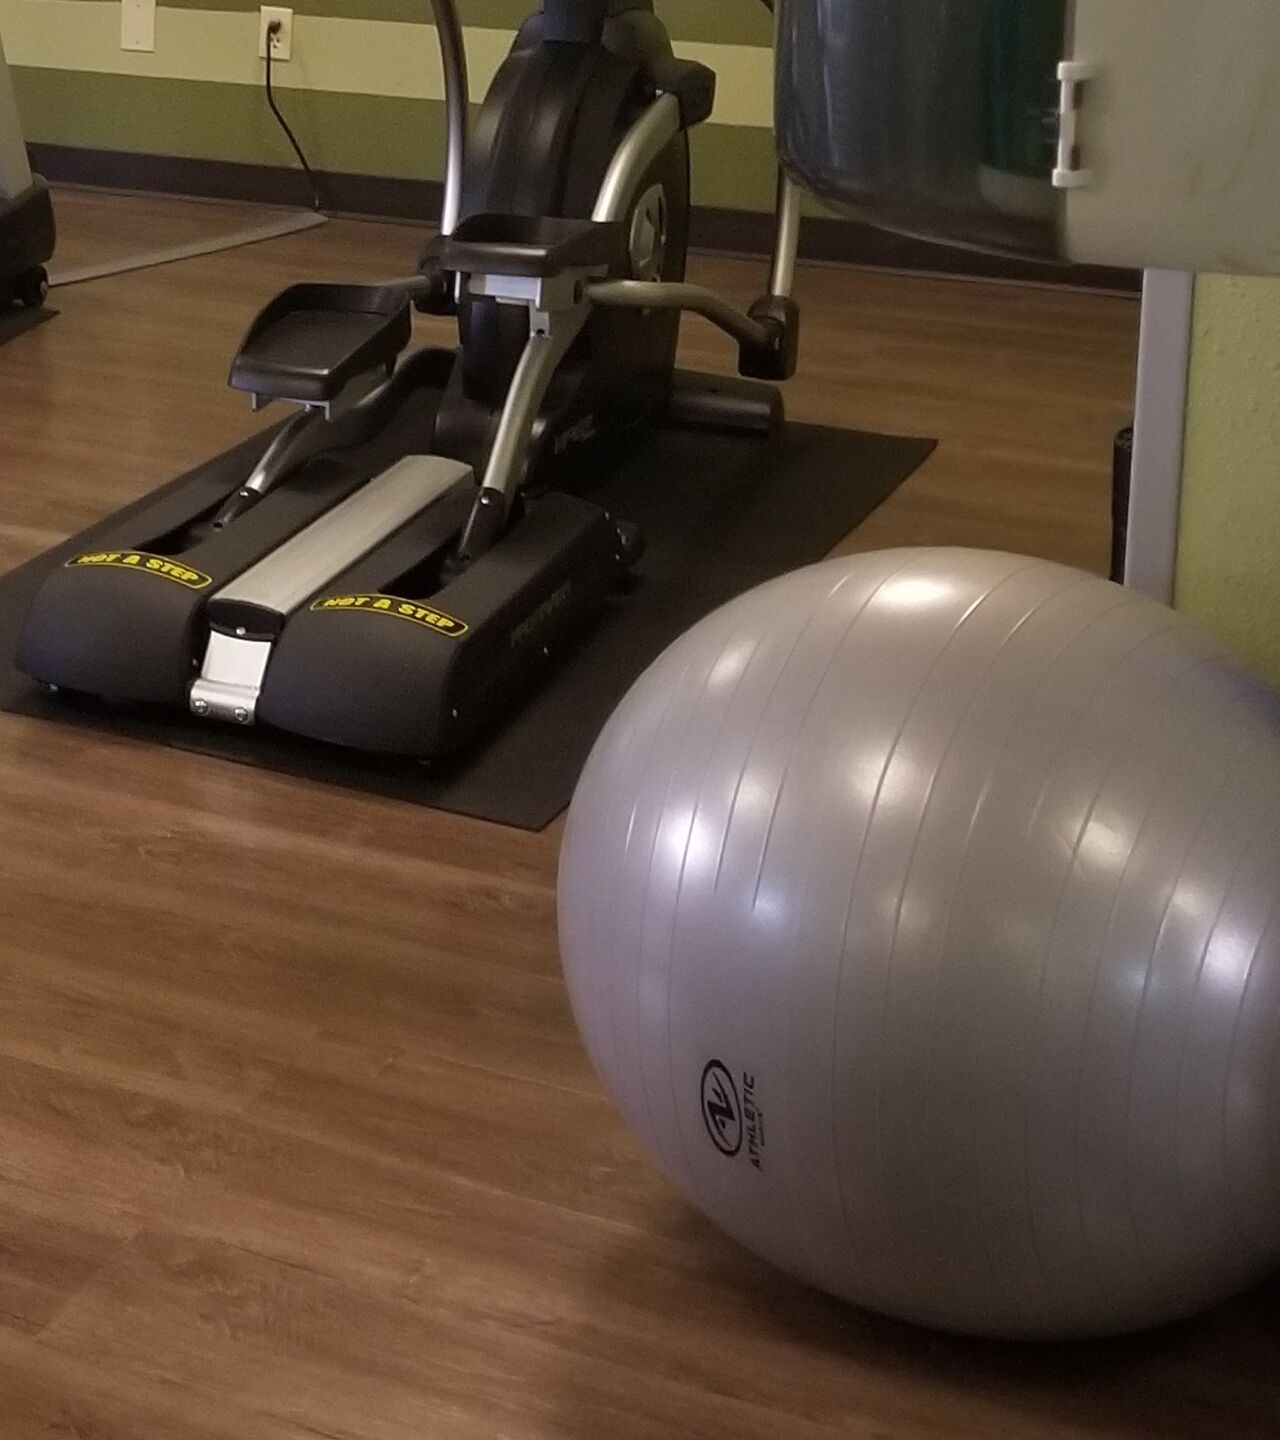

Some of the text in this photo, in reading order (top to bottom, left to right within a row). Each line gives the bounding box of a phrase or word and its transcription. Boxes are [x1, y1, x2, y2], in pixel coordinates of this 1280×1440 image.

[77, 554, 199, 581] NOT A STEP
[323, 597, 455, 628] NOT A STEP
[743, 1071, 764, 1172] ATHLETIC
